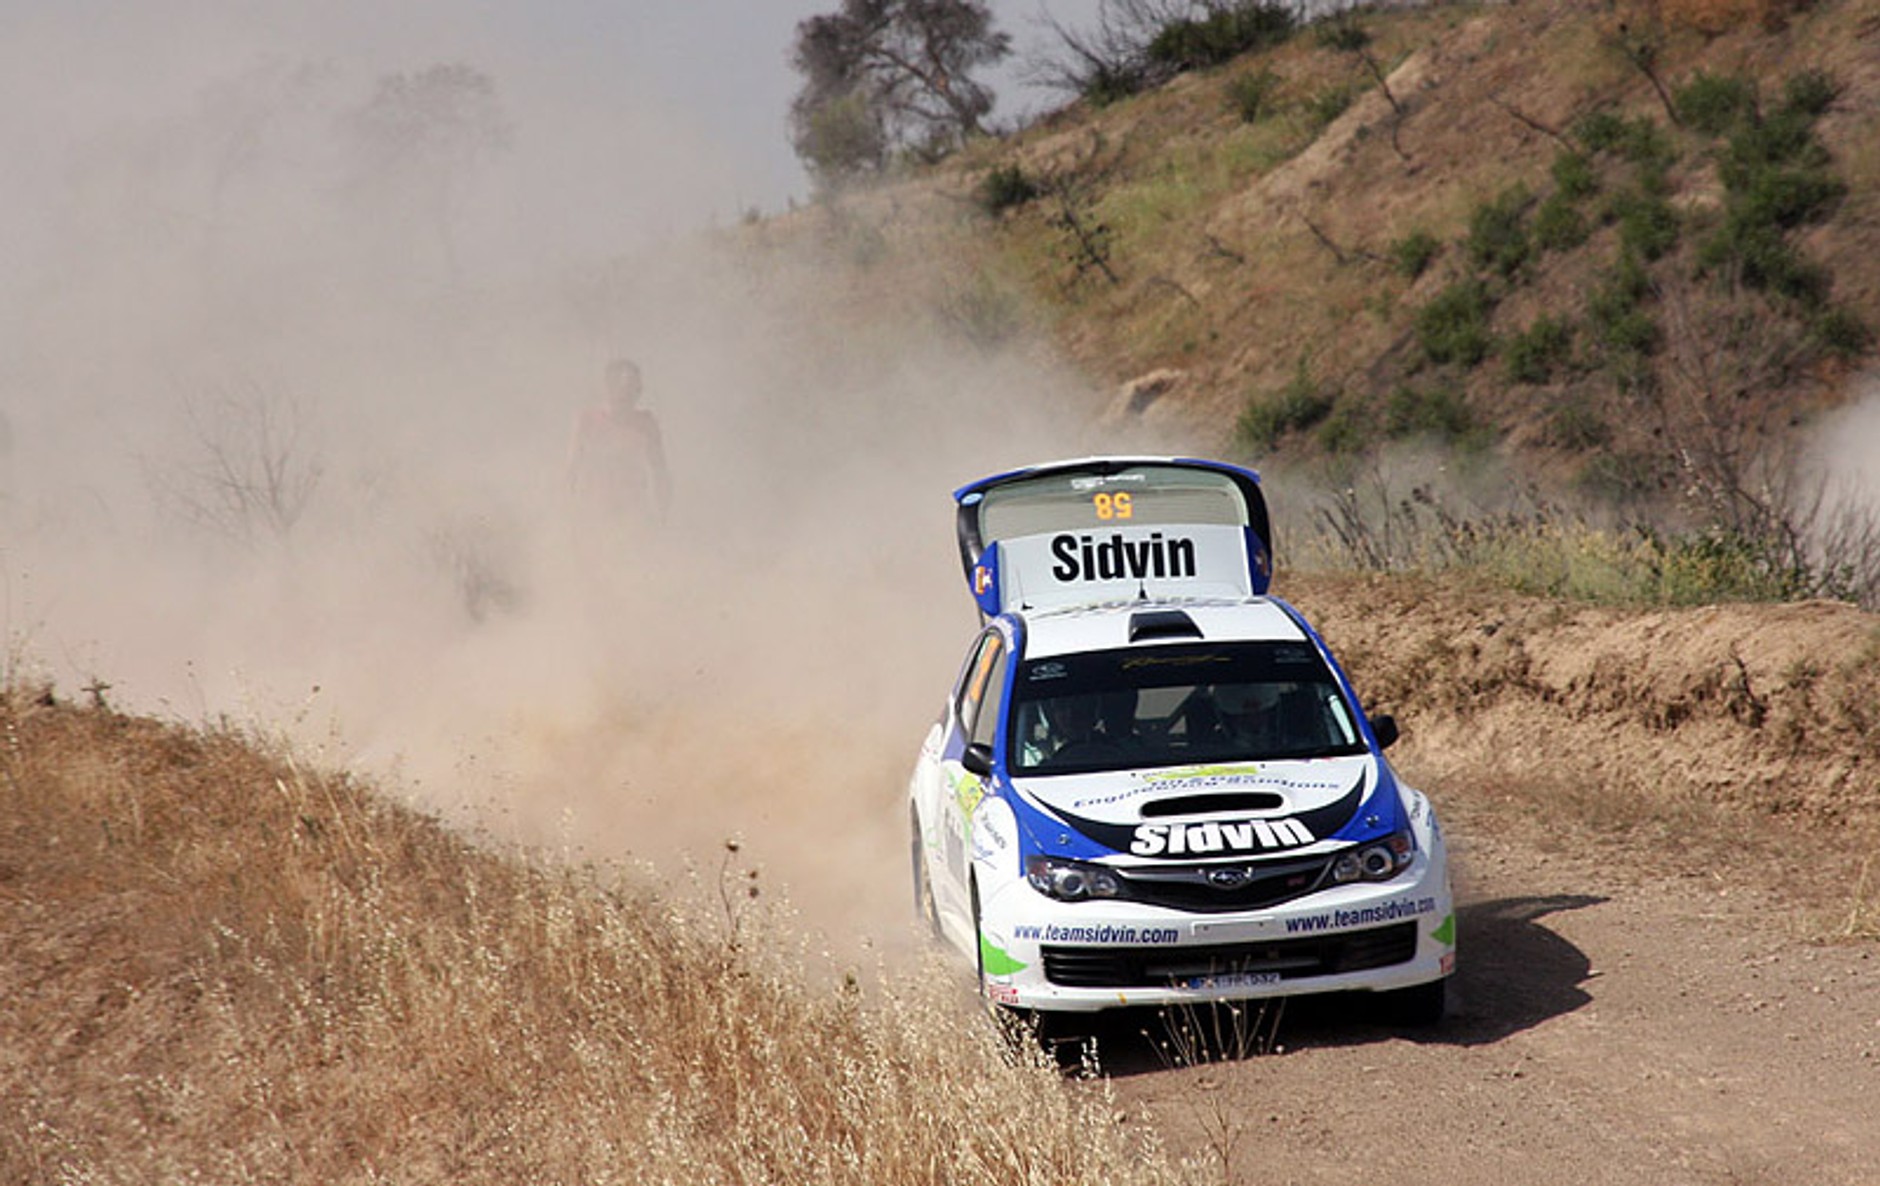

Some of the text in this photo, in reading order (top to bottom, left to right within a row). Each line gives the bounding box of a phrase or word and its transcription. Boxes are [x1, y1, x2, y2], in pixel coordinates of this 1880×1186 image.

[1093, 491, 1133, 520] 58
[1051, 532, 1196, 582] Sidvin
[1014, 923, 1179, 944] www.teamsidvin.com
